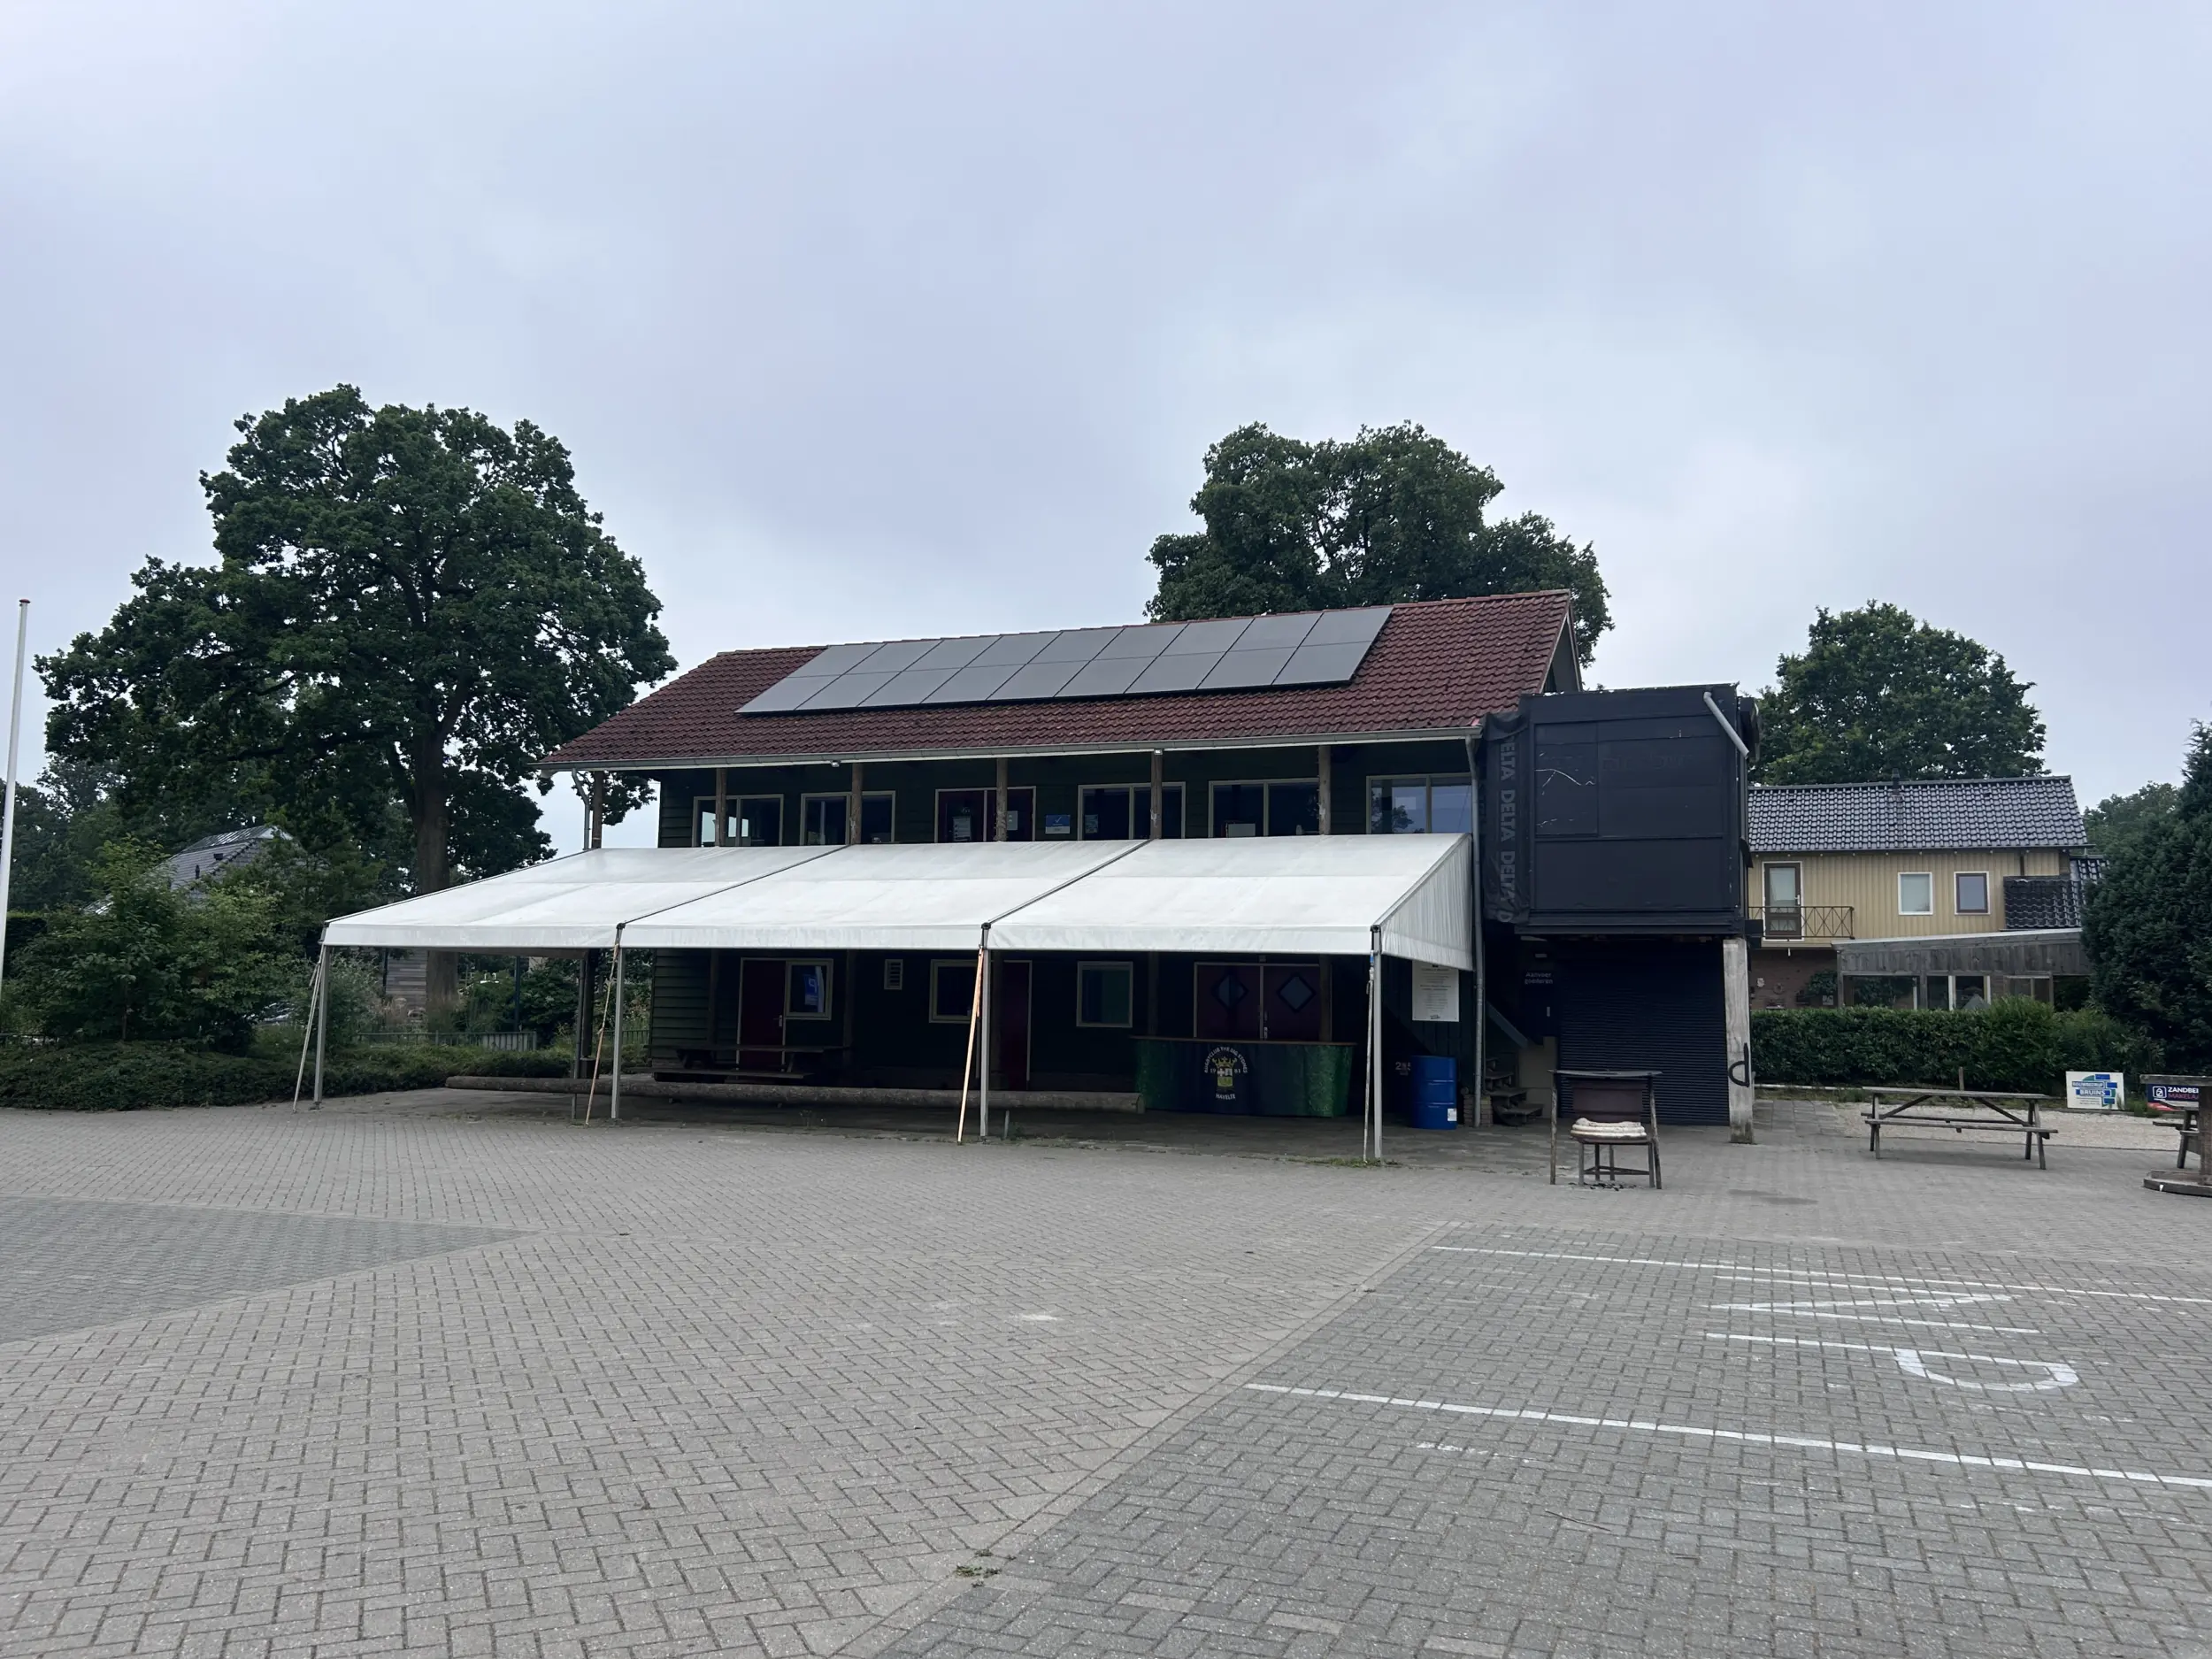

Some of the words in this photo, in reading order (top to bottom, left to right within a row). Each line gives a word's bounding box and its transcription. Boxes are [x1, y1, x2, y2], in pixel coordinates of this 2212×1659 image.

[1500, 789, 1516, 842] DELTA
[1204, 1047, 1220, 1073] RUGBYCLUB
[1230, 1048, 1239, 1056] BIG
[1238, 1054, 1248, 1073] STONES
